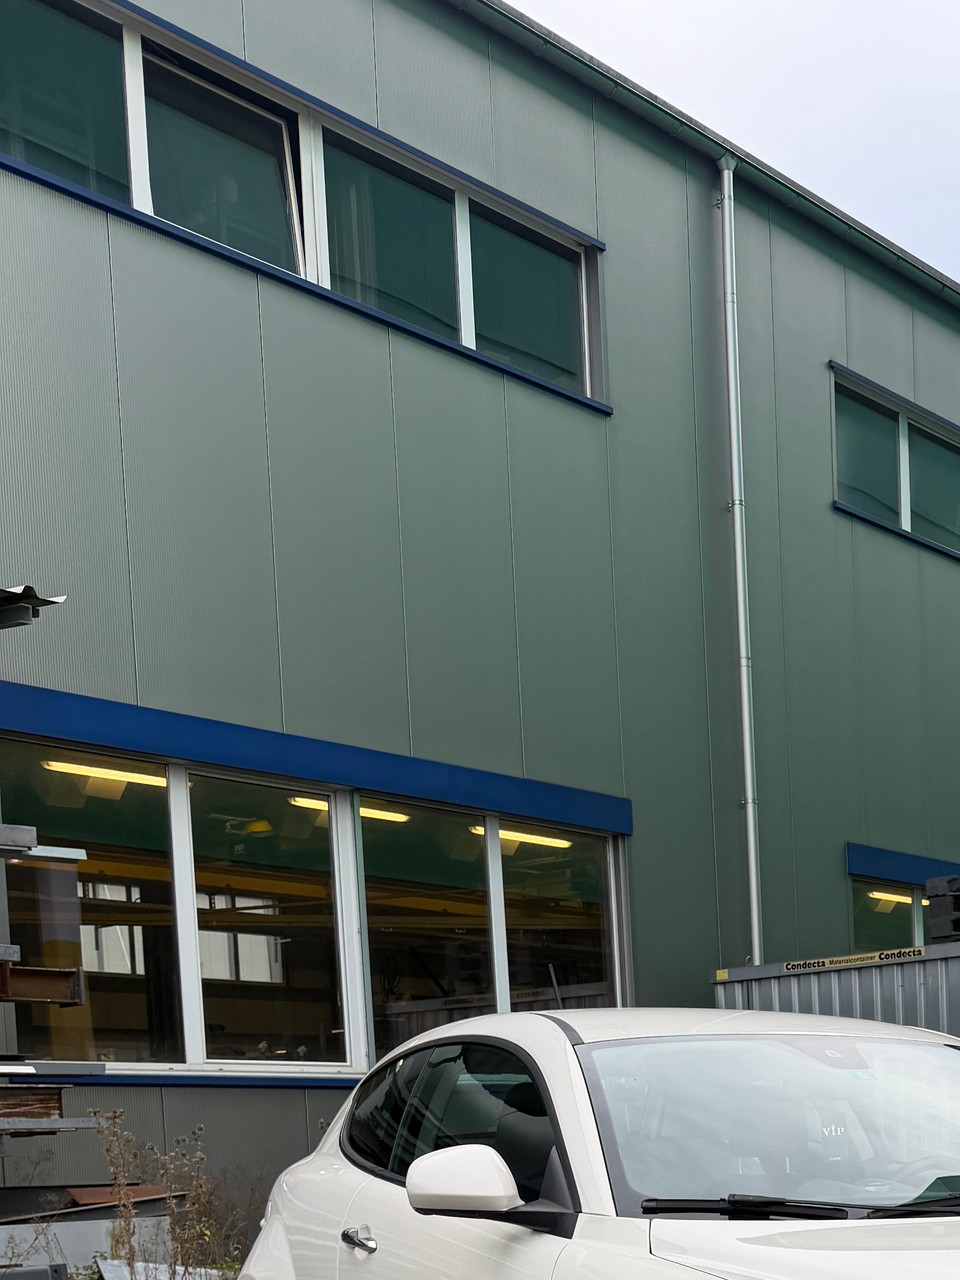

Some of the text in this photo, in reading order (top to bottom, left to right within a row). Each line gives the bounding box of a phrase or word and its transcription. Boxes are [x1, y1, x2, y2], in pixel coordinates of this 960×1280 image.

[785, 948, 922, 971] Condecta Materialcontainer Condecta
